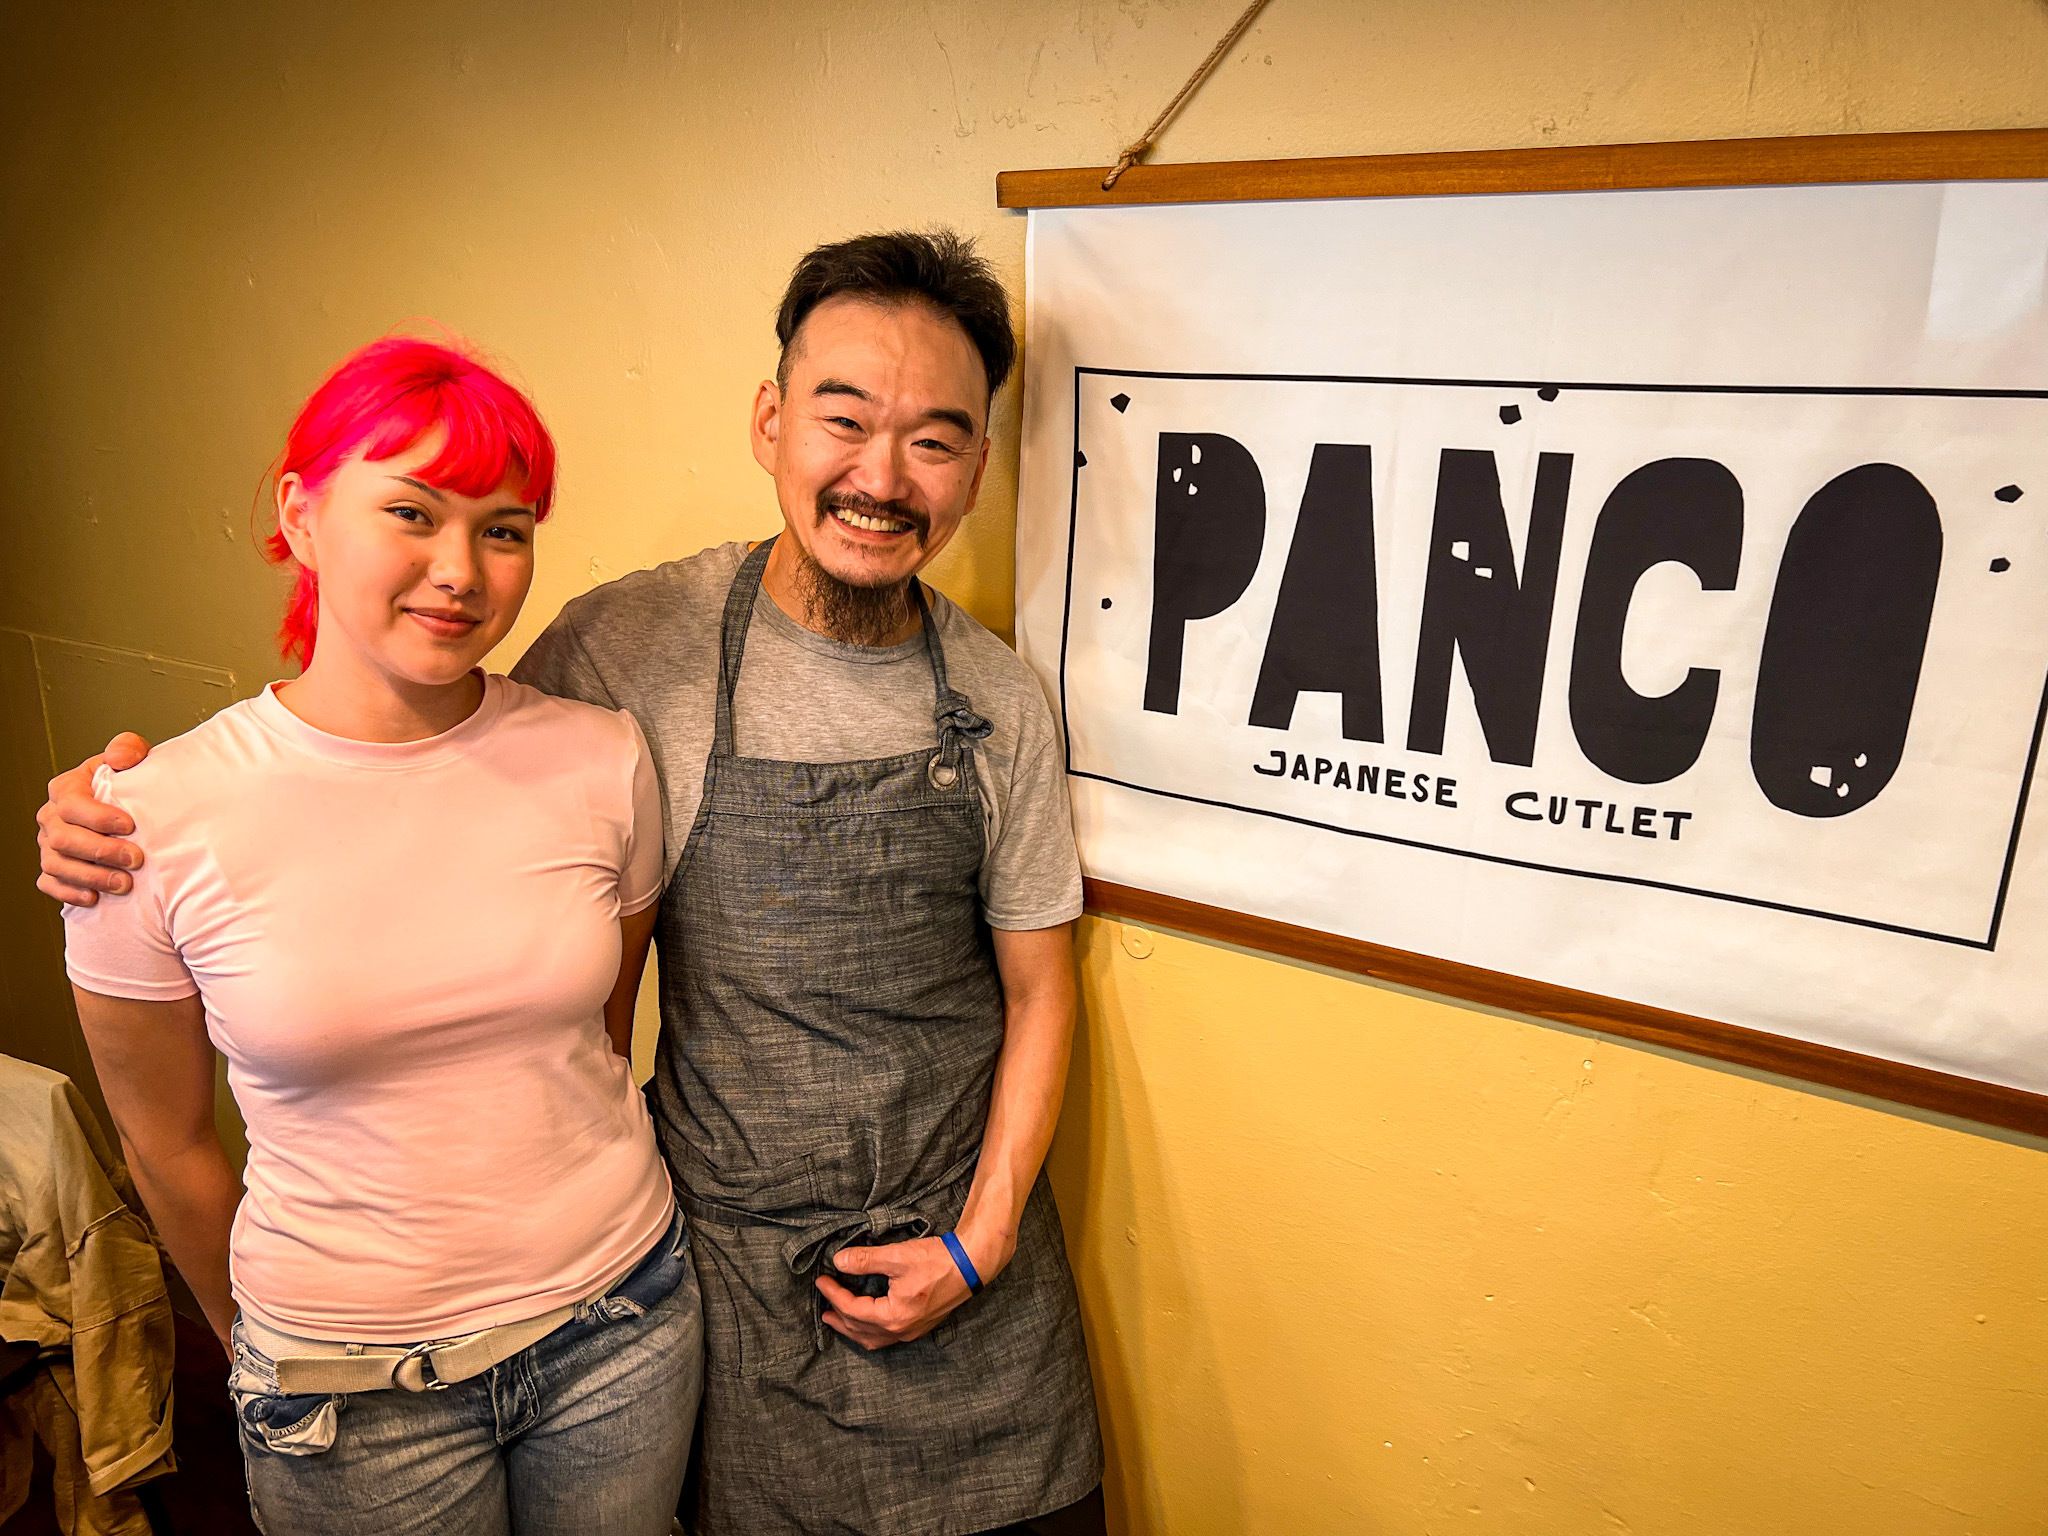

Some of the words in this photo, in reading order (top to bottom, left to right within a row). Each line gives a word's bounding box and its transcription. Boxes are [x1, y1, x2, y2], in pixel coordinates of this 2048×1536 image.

[1144, 431, 1943, 818] PANCO
[1253, 750, 1458, 809] JAPANESE
[1505, 791, 1693, 841] CUTLET
